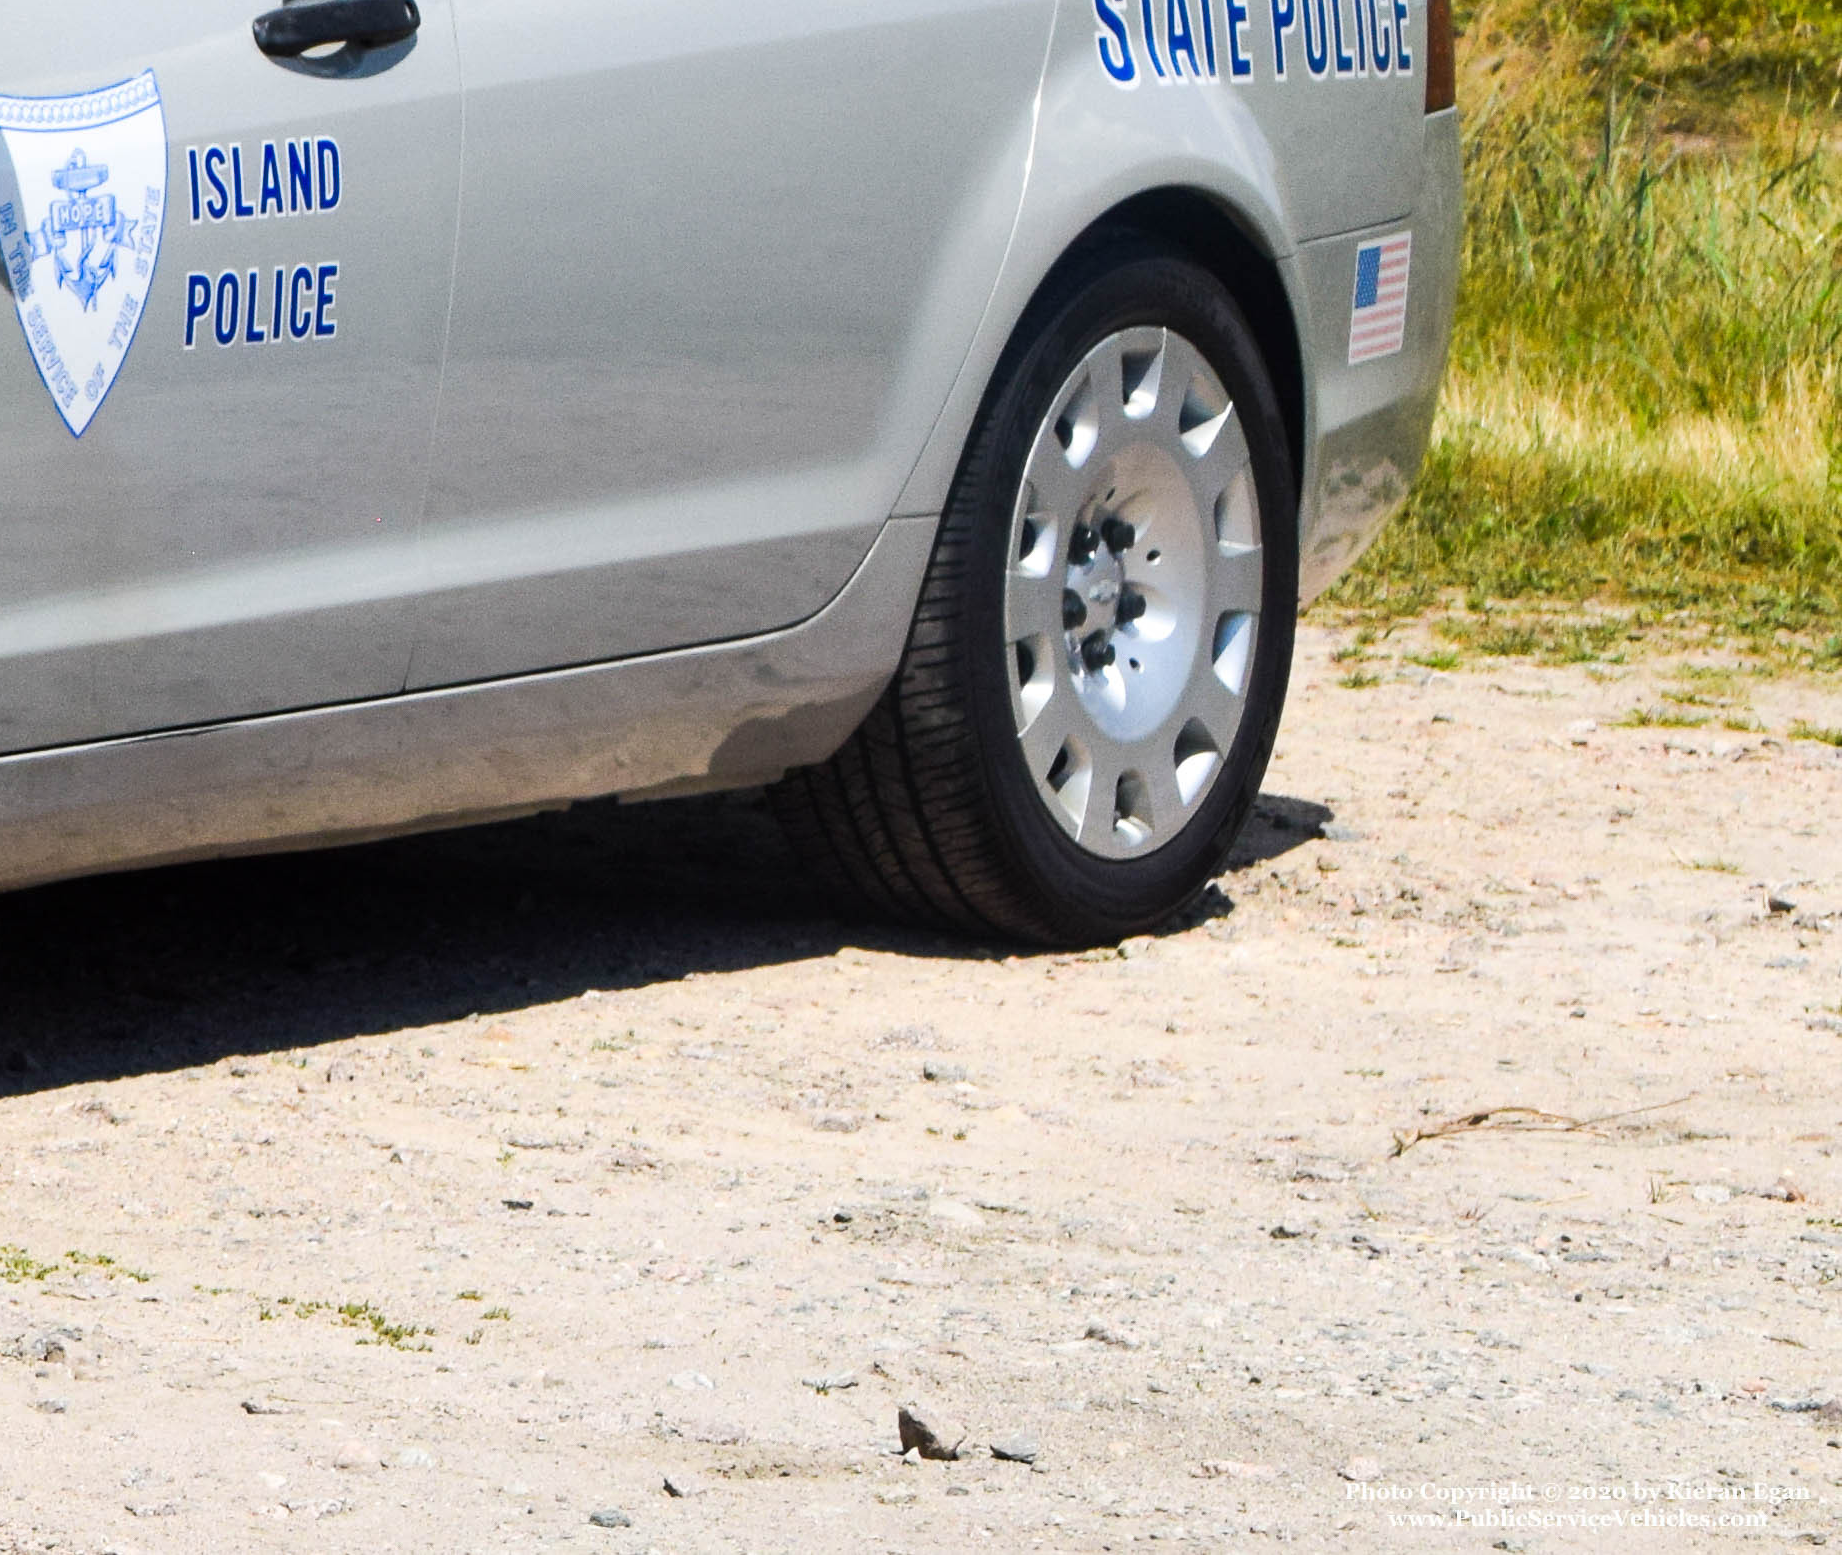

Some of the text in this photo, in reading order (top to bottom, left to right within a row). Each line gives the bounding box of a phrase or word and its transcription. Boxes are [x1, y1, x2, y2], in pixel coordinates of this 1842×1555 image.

[58, 202, 105, 224] HOPE
[187, 138, 341, 221] ISLAND
[27, 304, 79, 409] SERVICE
[84, 361, 106, 402] OF
[108, 293, 139, 350] THE
[135, 185, 161, 279] STATE
[185, 265, 338, 347] POLICE
